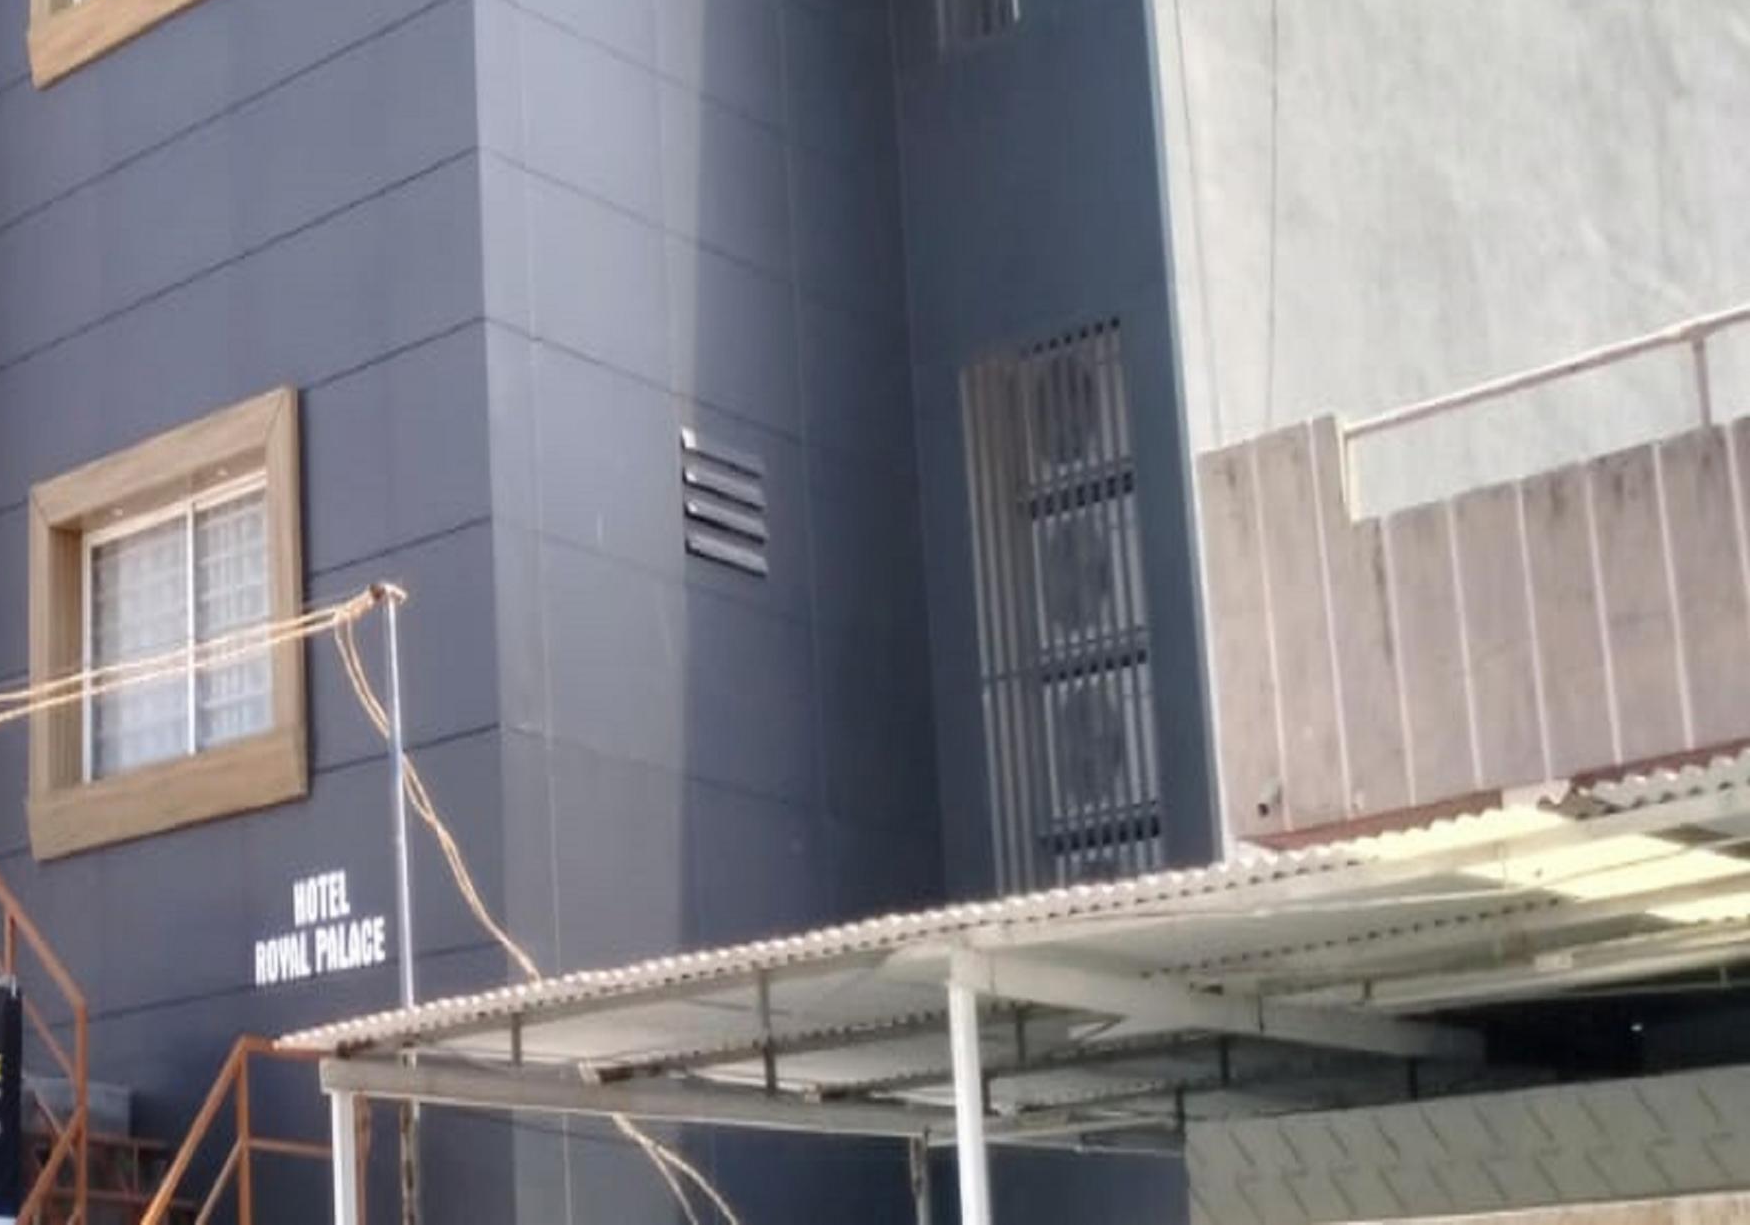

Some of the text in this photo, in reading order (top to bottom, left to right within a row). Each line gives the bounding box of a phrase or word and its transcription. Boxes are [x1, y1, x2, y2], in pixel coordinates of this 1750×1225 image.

[293, 869, 350, 927] HOTEL
[255, 916, 386, 986] ROYAL PALACE
